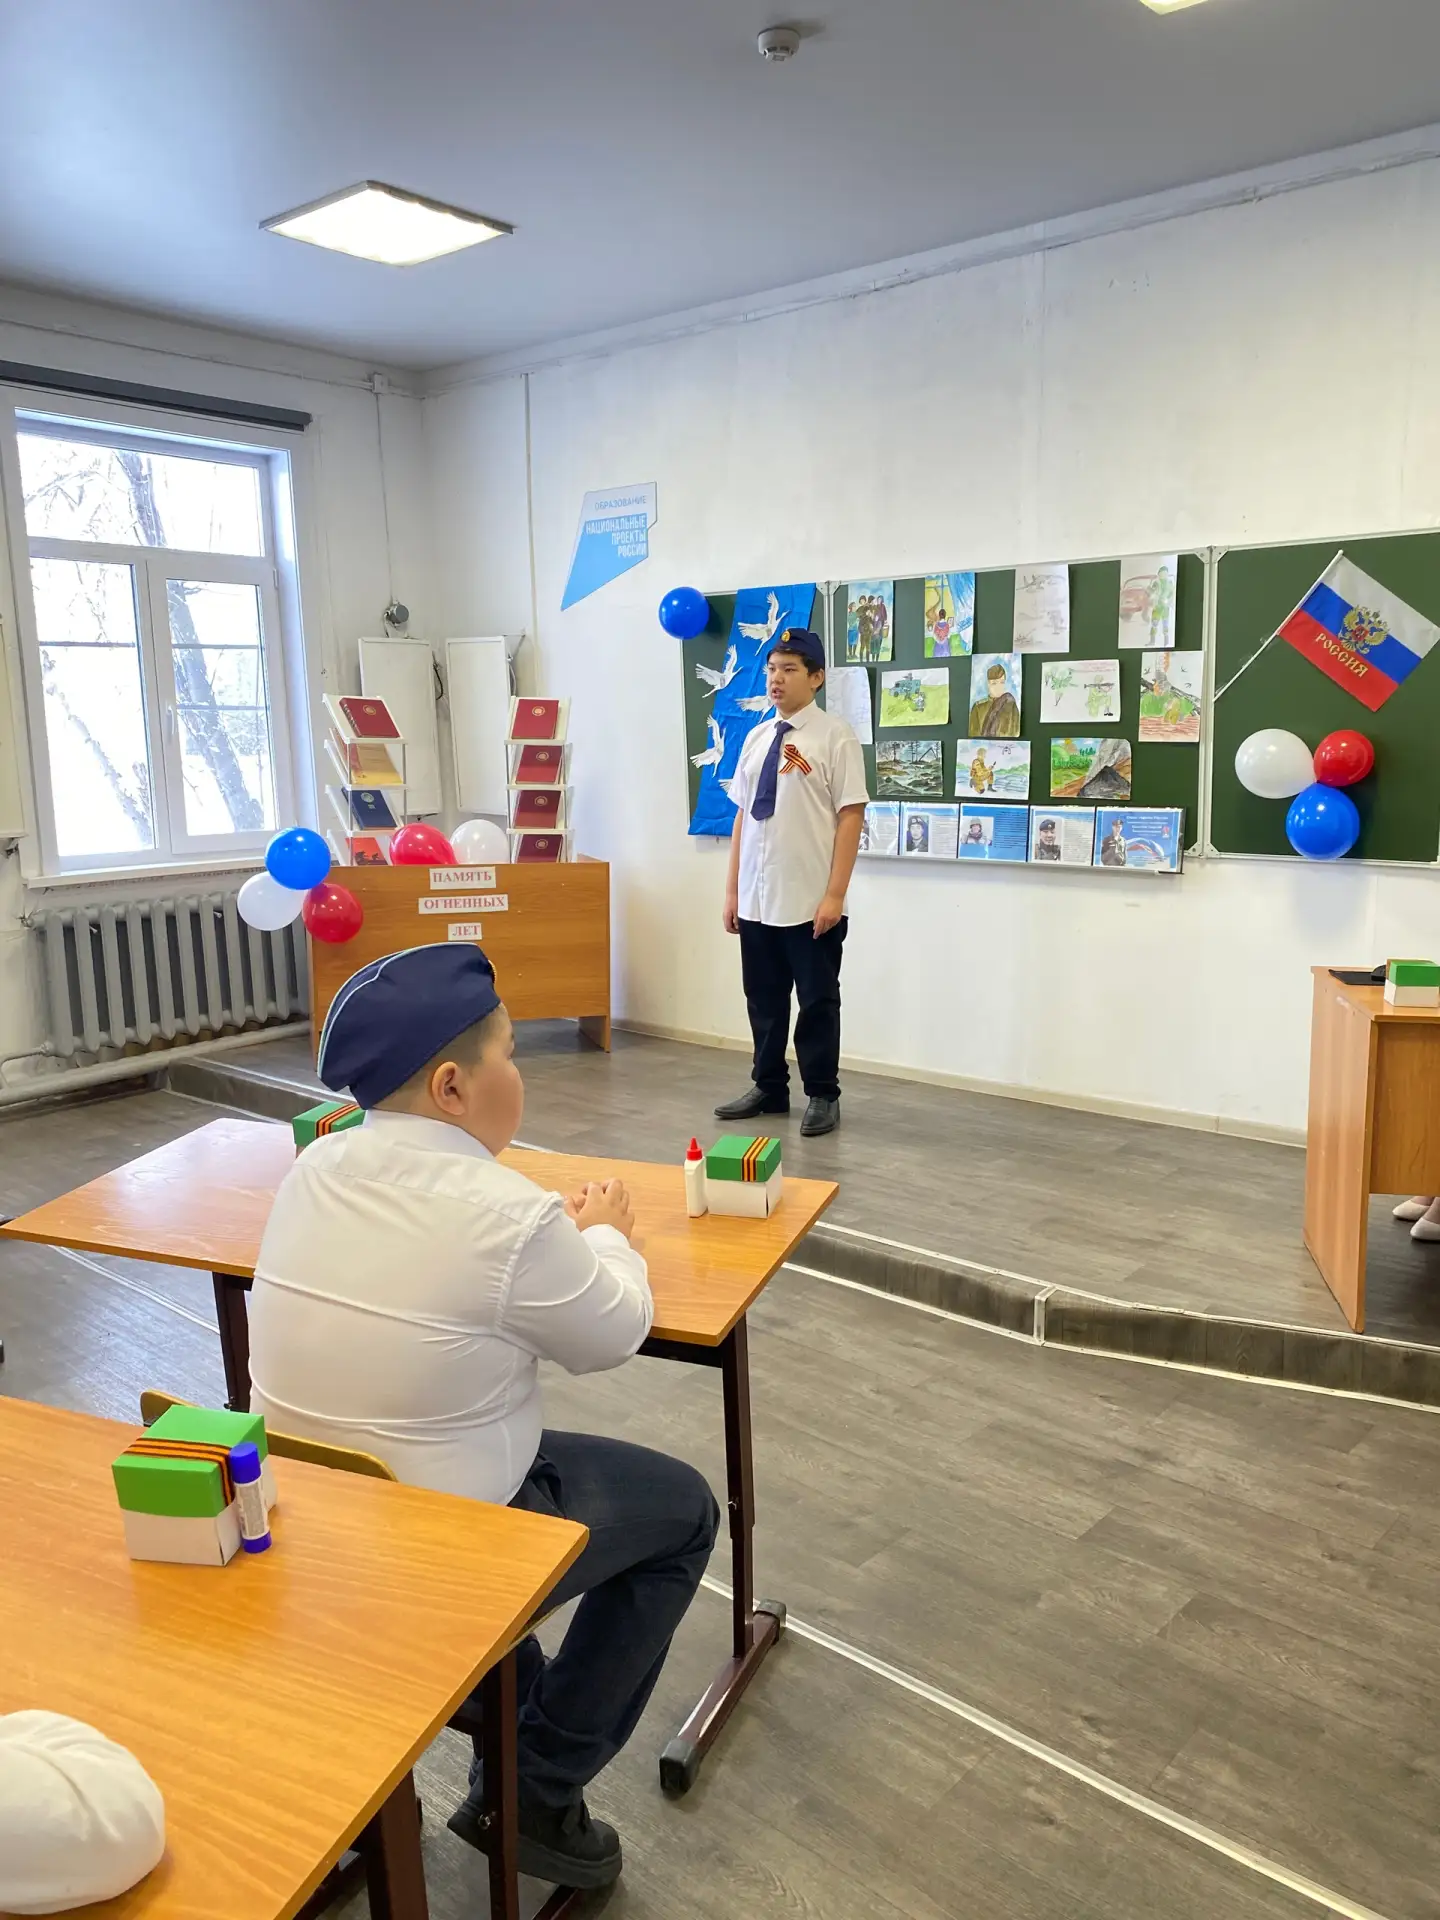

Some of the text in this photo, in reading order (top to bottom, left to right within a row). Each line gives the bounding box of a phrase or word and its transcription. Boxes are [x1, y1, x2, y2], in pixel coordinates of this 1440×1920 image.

[595, 495, 647, 511] ОБРАЗОВАНИЕ
[586, 514, 646, 534] НАЦИОНАЛЬНЫЕ
[612, 530, 646, 545] ПРОЕКТЫ
[618, 544, 646, 557] РОССИИ
[1315, 633, 1368, 677] РОССИЯ
[433, 871, 492, 882] ПАМЯТЬ
[424, 896, 505, 909] ОГНЕННЫХ
[452, 925, 481, 936] ЛЕТ
